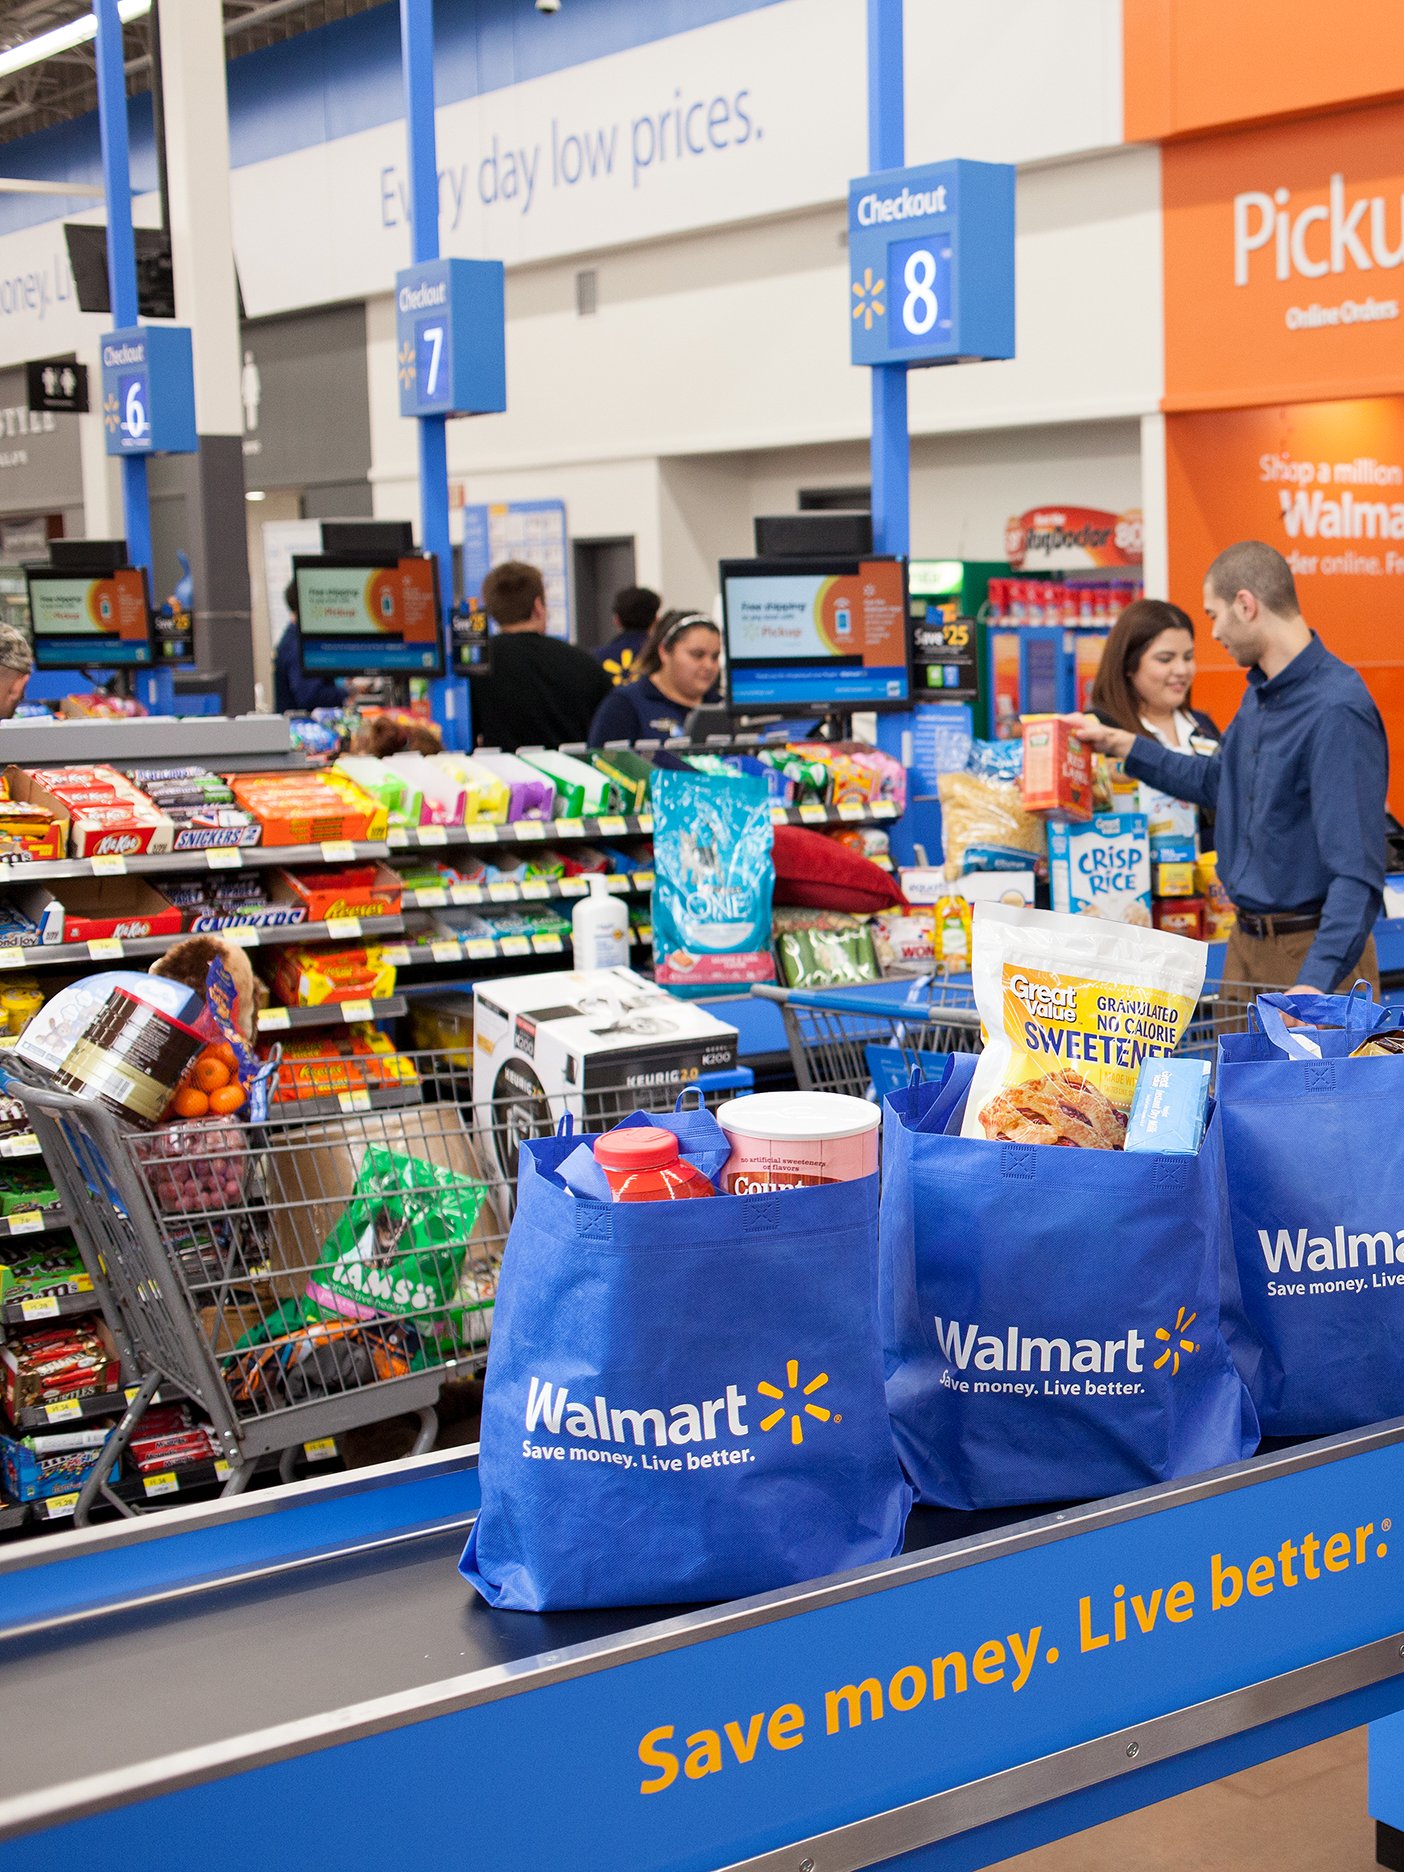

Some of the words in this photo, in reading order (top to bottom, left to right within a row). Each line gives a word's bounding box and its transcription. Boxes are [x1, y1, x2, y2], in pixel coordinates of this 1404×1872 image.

[380, 164, 468, 231] Evry
[478, 135, 541, 215] day
[551, 118, 619, 187] low
[631, 87, 764, 190] prices.
[856, 184, 948, 228] Checkout
[399, 281, 447, 313] Checkout
[902, 249, 938, 336] 8
[1285, 303, 1340, 331] Online
[1339, 296, 1400, 325] Orders
[103, 342, 145, 368] Checkout
[423, 326, 444, 396] 7
[125, 381, 146, 439] 6
[1258, 452, 1315, 487] Shop
[1317, 461, 1331, 484] a
[1333, 457, 1403, 486] million
[1320, 549, 1384, 577] online.
[914, 628, 944, 646] Save
[176, 827, 241, 848] SNICKERS
[686, 891, 749, 920] ONE
[1010, 974, 1077, 1009] Great
[1025, 999, 1077, 1024] Value
[1097, 996, 1178, 1024] GRANULATED
[1097, 1014, 1120, 1033] NO
[1125, 1018, 1176, 1045] CALORIE
[702, 1051, 731, 1066] K200
[504, 1067, 533, 1095] KEURIG
[627, 1069, 680, 1087] KEURIG
[680, 1067, 699, 1081] 2.0
[749, 1156, 782, 1165] artificial
[781, 1158, 827, 1168] sweeteners
[772, 1163, 800, 1172] flavors
[332, 1262, 414, 1305] IAMS
[1267, 1281, 1305, 1296] Save
[1309, 1277, 1368, 1295] money.
[1372, 1273, 1404, 1289] Live
[934, 1316, 1145, 1373] Walmart
[46, 1385, 96, 1404] TURTLES
[939, 1369, 969, 1393] Save
[974, 1382, 1039, 1397] money.
[1044, 1380, 1082, 1395] Live
[1085, 1380, 1146, 1396] better.
[524, 1376, 749, 1447] Walmart
[522, 1440, 565, 1461] Save
[569, 1447, 638, 1470] money.
[642, 1454, 683, 1472] Live
[687, 1448, 756, 1471] better.
[637, 1701, 806, 1795] Save
[823, 1626, 1060, 1735] money.
[1078, 1578, 1194, 1654] Live
[1210, 1523, 1389, 1610] better.
